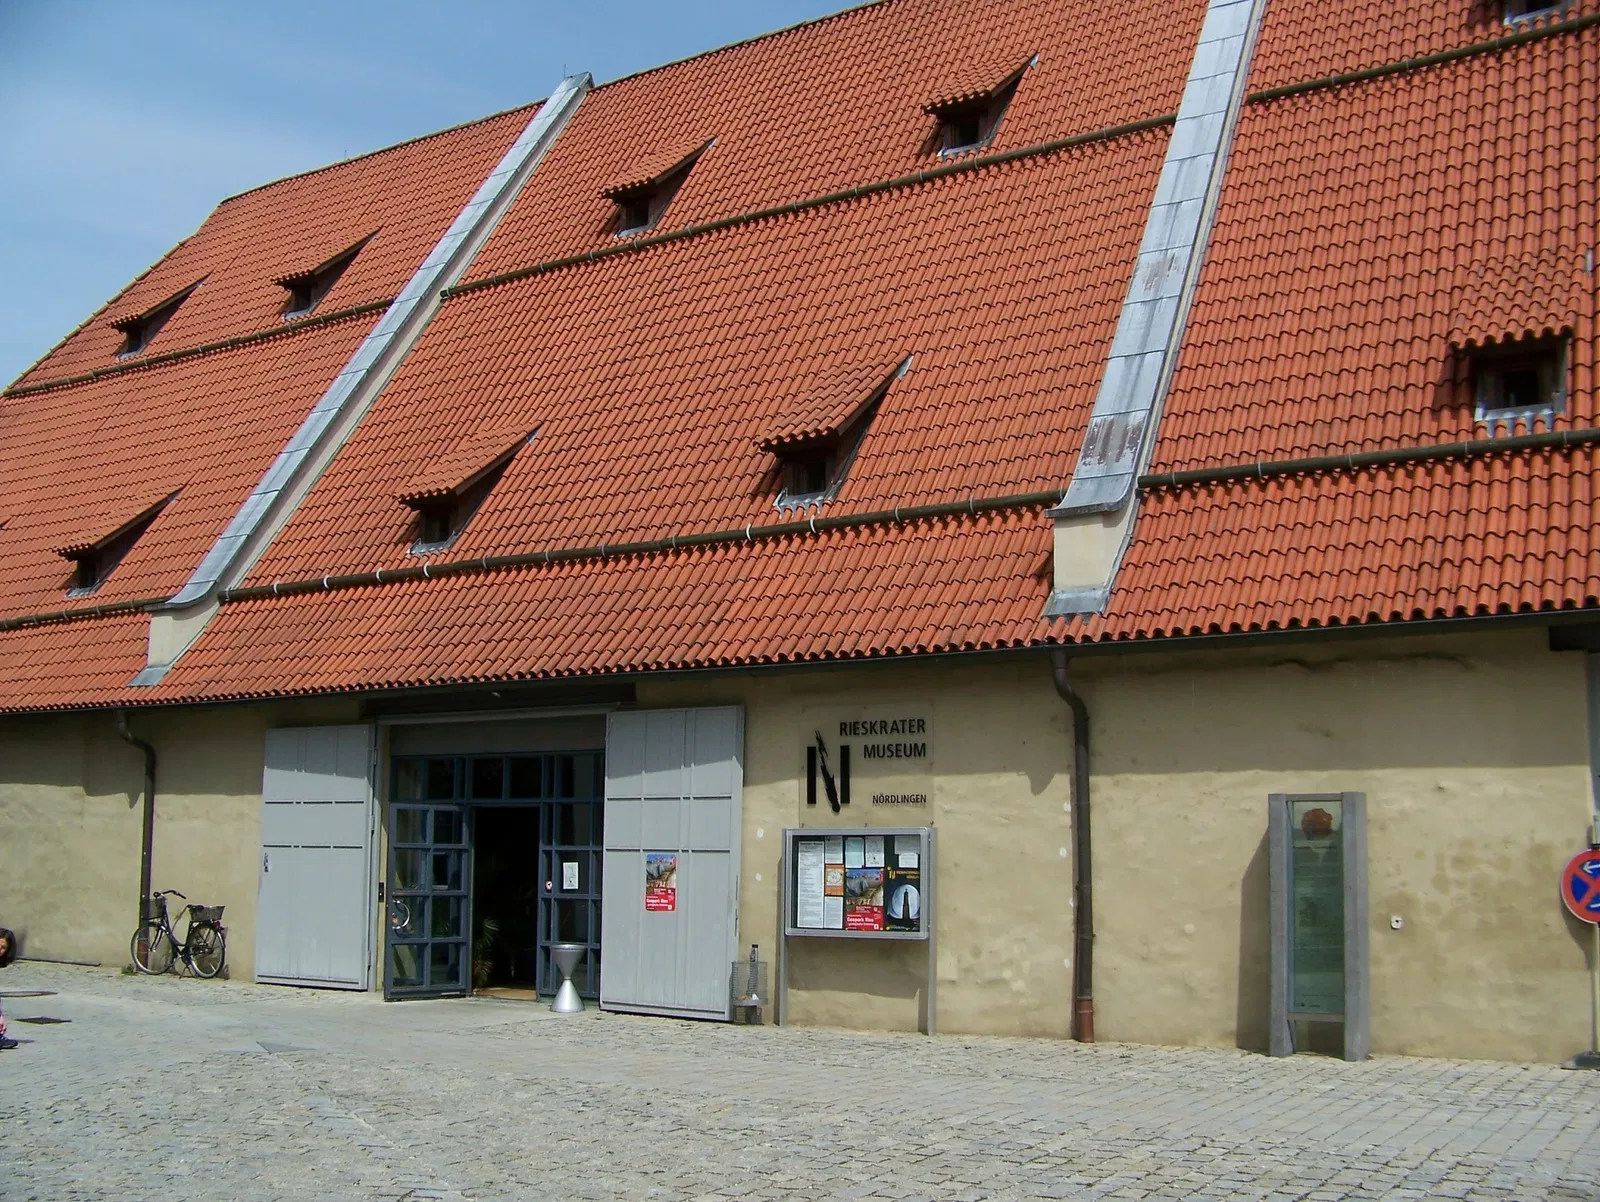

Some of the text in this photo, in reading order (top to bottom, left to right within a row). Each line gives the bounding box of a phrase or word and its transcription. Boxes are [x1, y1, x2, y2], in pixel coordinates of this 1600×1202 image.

[840, 719, 926, 736] RIESKRATER
[863, 743, 926, 759] MUSEUM
[872, 793, 927, 804] NÖRDLINGEN
